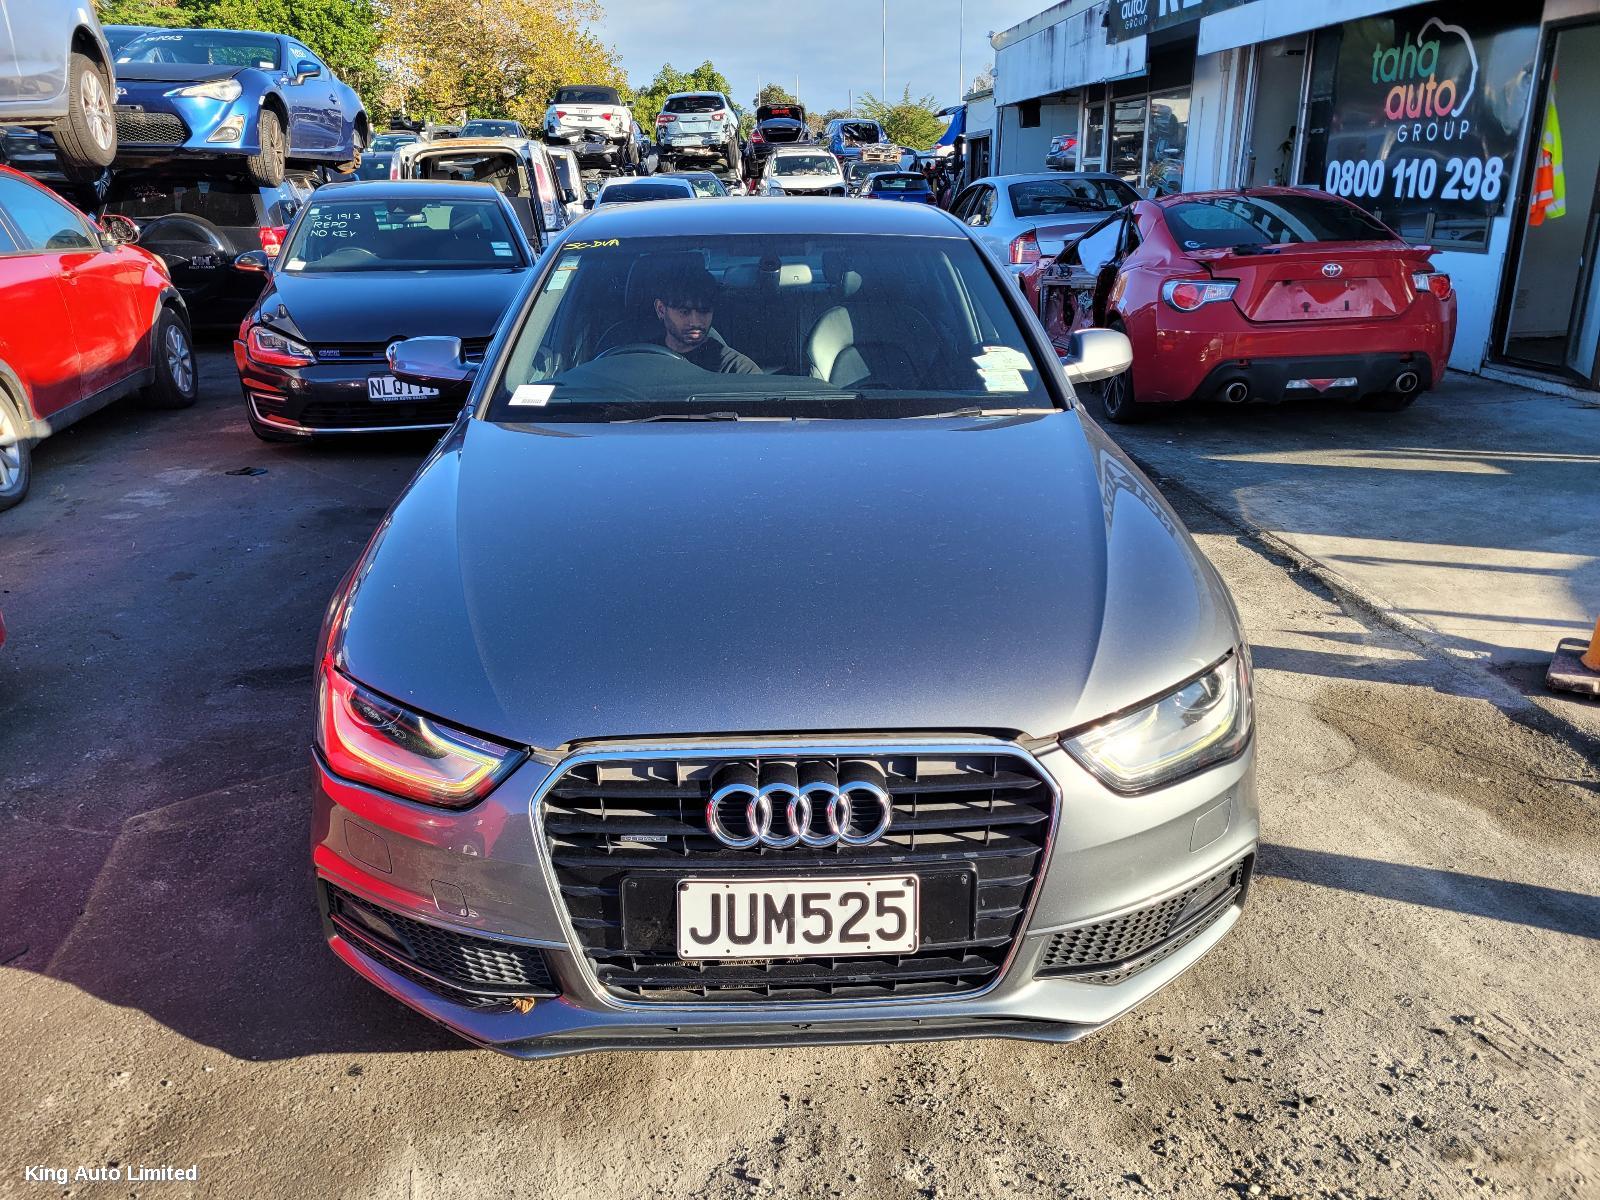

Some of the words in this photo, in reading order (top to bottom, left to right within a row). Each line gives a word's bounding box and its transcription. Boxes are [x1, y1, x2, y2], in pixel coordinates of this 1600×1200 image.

[1124, 14, 1148, 30] GROUP
[1370, 32, 1441, 84] taha
[1384, 73, 1457, 120] auto
[1397, 120, 1470, 142] GROUP
[1325, 159, 1385, 197] 0800
[1392, 158, 1437, 199] 110
[1440, 156, 1504, 200] 298
[310, 229, 328, 237] NO
[332, 230, 357, 238] KEY
[313, 221, 348, 229] REPO
[688, 890, 907, 945] JUM525
